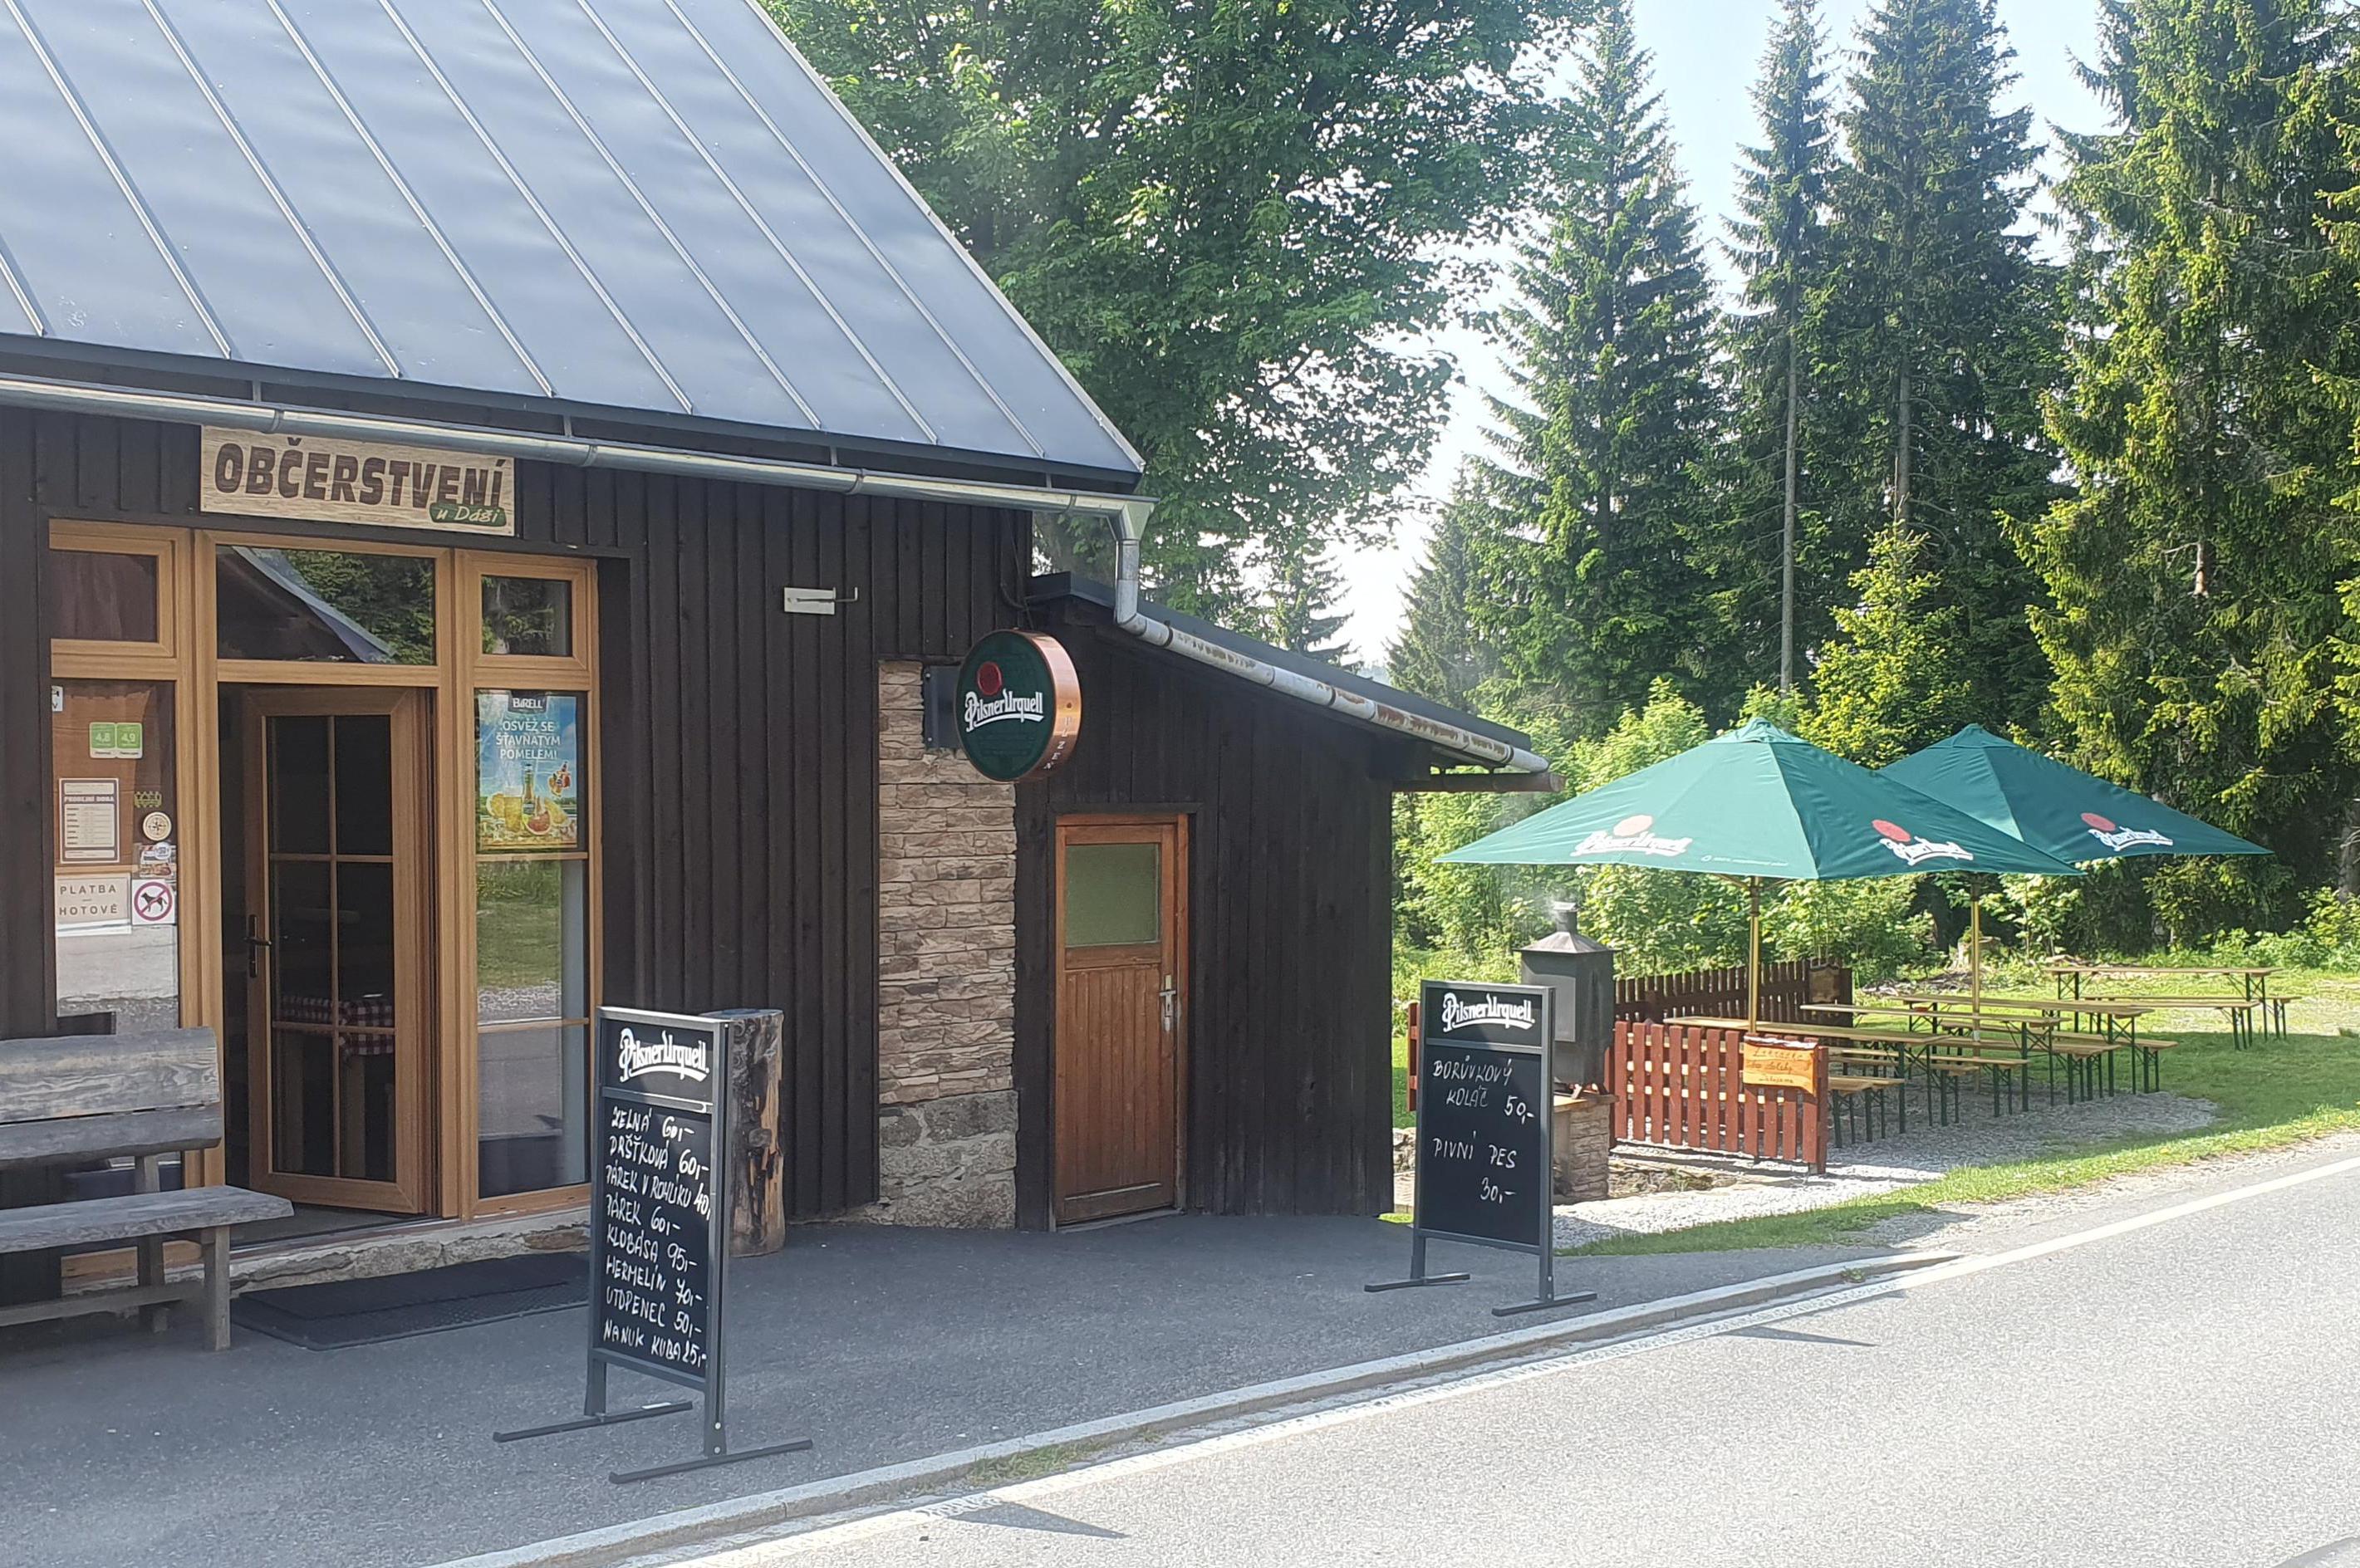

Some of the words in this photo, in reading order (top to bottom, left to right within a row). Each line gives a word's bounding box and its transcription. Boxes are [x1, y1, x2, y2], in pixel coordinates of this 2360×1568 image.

[214, 437, 505, 508] OBČERSTVENÍ
[541, 721, 555, 732] SE
[964, 691, 1003, 733] Pilsner
[1003, 688, 1043, 723] Urquell
[60, 884, 116, 895] PLATBA
[1441, 992, 1489, 1032] Pilsner
[1486, 993, 1535, 1029] Urquell
[619, 1028, 667, 1082] Pilsner
[661, 1031, 709, 1080] Urquell
[1504, 1095, 1535, 1125] 50,-
[610, 1134, 670, 1170] DRŠŤKOVÁ
[679, 1149, 709, 1180] 60,-
[1432, 1130, 1477, 1159] PIVNÍ
[1489, 1144, 1517, 1169] PES
[606, 1159, 637, 1193] PÁREK
[642, 1174, 649, 1195] V
[1480, 1177, 1517, 1204] 30,-
[606, 1192, 641, 1226] PÁREK
[650, 1206, 681, 1236] 60,-
[606, 1223, 659, 1263] KLOBÁSA
[667, 1242, 698, 1272] 95,-
[606, 1254, 666, 1291] HERMELÍN
[606, 1286, 665, 1327] UTOPENEC
[674, 1311, 702, 1338] 50,-
[603, 1318, 644, 1347] NANUK
